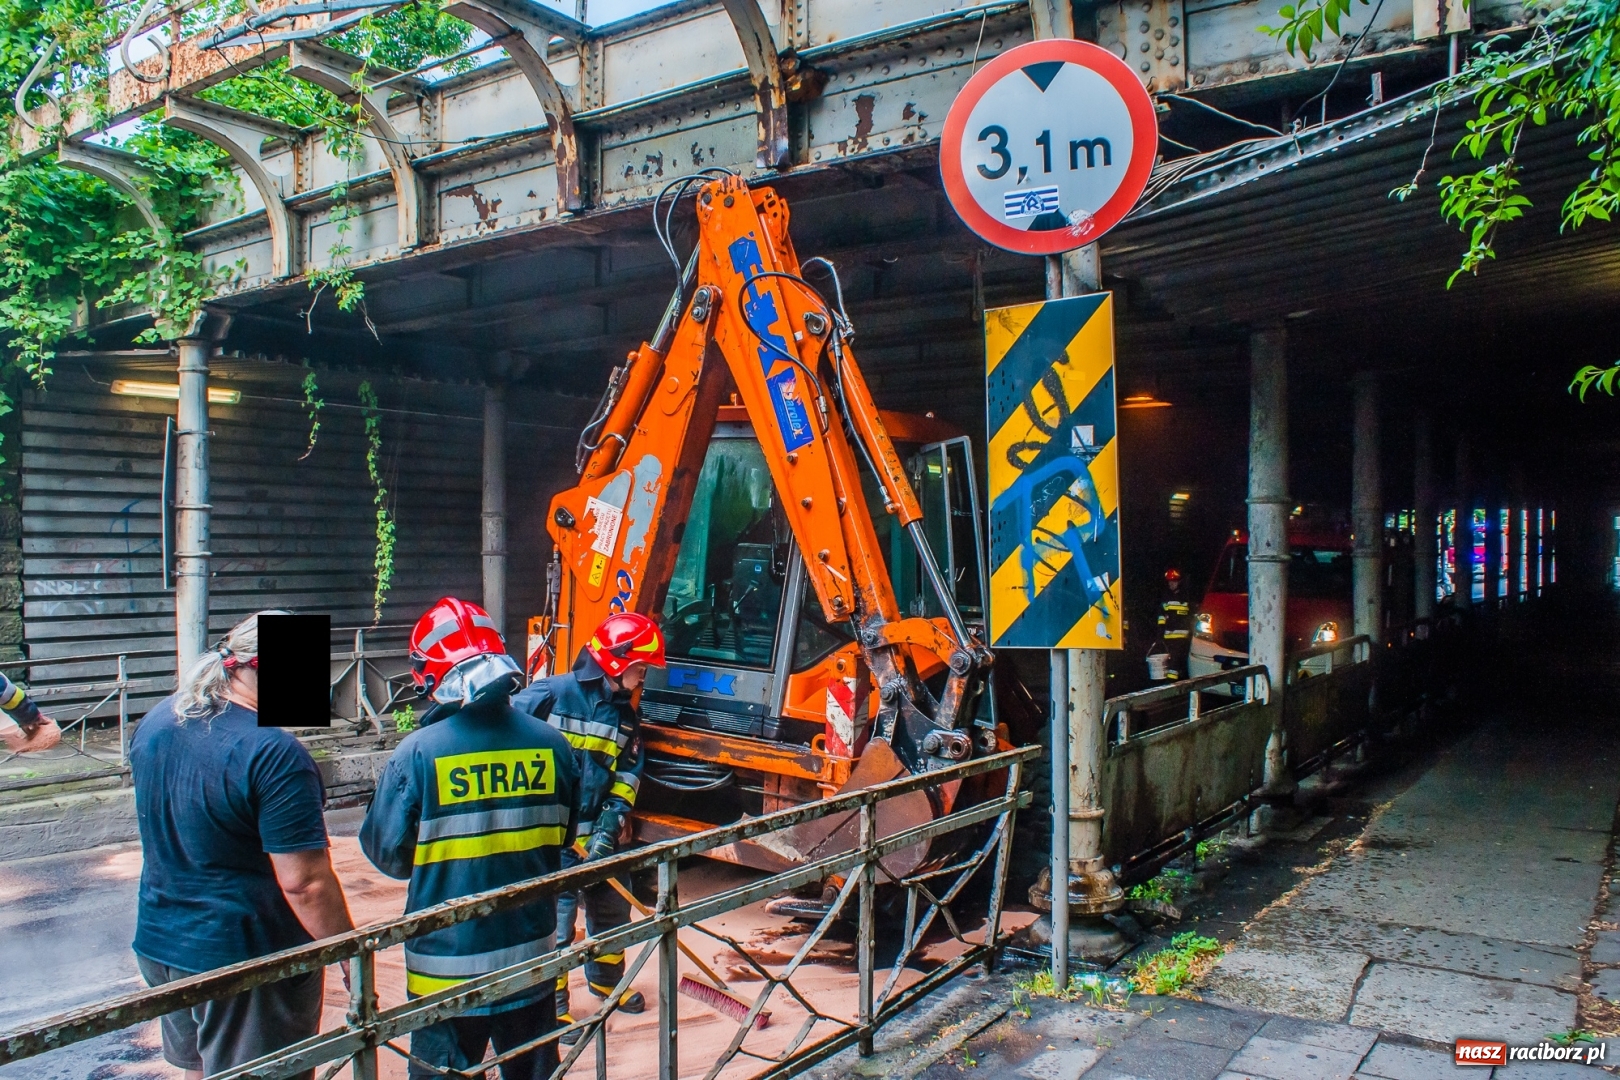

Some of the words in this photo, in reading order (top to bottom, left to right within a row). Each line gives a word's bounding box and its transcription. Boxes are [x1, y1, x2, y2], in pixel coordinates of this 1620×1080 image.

[977, 125, 1052, 184] 3,1
[1070, 137, 1112, 170] m
[449, 753, 547, 798] STRAŻ
